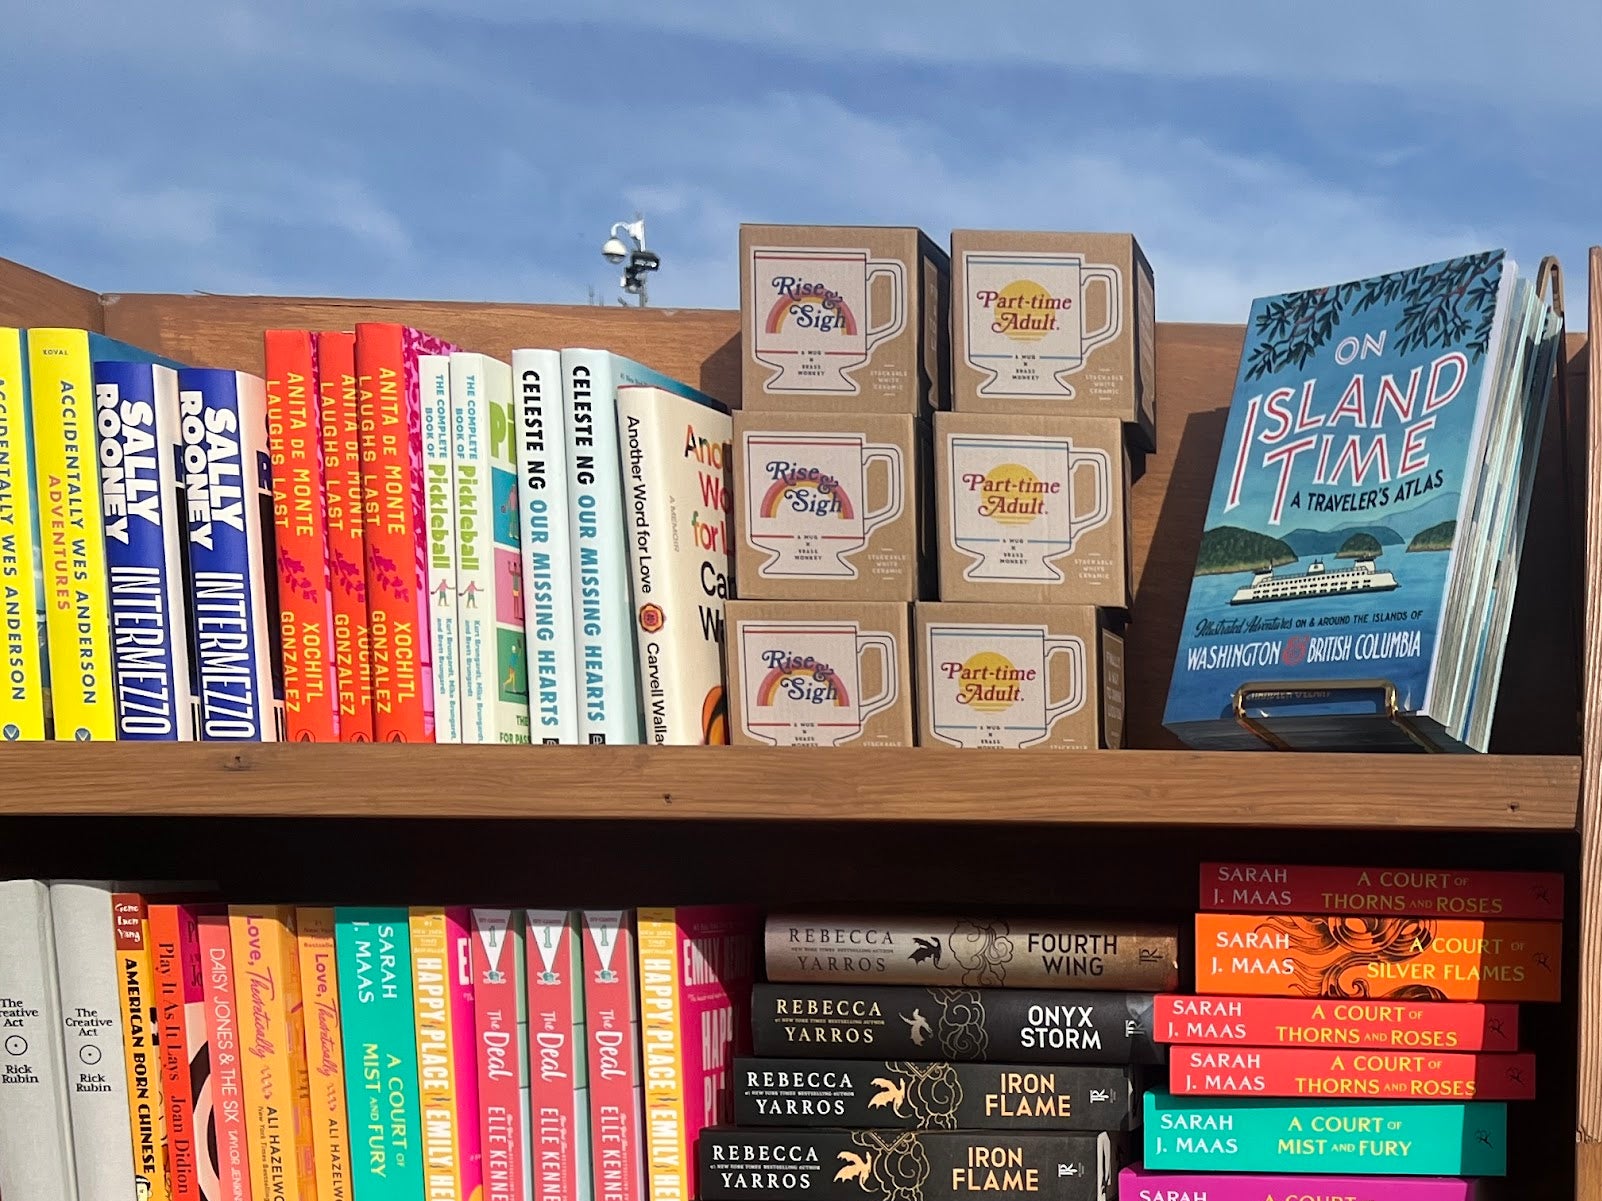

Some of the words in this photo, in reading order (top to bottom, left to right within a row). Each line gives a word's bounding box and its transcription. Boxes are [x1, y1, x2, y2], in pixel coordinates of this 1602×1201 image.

[772, 276, 824, 297] Rise
[976, 290, 1072, 314] Part-time
[790, 304, 847, 332] Sigh
[991, 313, 1060, 334] Adult.
[1335, 329, 1387, 366] ON
[287, 372, 302, 429] ANITA
[522, 369, 545, 452] CELESTE
[265, 379, 286, 466] LAUGHS
[1223, 351, 1470, 516] ISLAND
[60, 379, 84, 529] ACCIDENTALLY
[95, 383, 130, 546] ROONEY
[121, 399, 160, 526] SALLY
[291, 438, 305, 457] DE
[626, 415, 642, 479] Another
[527, 459, 546, 491] NG
[1262, 415, 1437, 526] TIME
[1291, 490, 1301, 509] A
[1307, 488, 1391, 513] TRAVELER'S
[1394, 469, 1444, 503] ATLAS
[272, 477, 289, 529] LAST
[292, 467, 314, 538] MONTE
[458, 464, 480, 571] Pickleball
[635, 481, 648, 517] Word
[529, 499, 549, 544] OUR
[636, 519, 648, 538] for
[48, 475, 71, 611] ADVENTURES
[72, 538, 88, 581] WES
[640, 540, 651, 594] Love
[533, 552, 554, 642] MISSING
[1295, 619, 1310, 630] ON
[1317, 616, 1351, 628] AROUND
[1353, 613, 1368, 624] THE
[1372, 611, 1408, 623] ISLANDS
[1411, 610, 1423, 620] OF
[75, 589, 97, 705] ANDERSON
[110, 565, 172, 736] INTERMEZZO
[280, 610, 300, 714] GONZALEZ
[301, 622, 323, 704] XOCHITL
[1187, 639, 1280, 671] WASHINGTON
[1307, 636, 1351, 663] BRITISH
[1355, 630, 1422, 660] COLUMBIA
[537, 649, 559, 727] HEARTS
[646, 641, 662, 700] Carvell
[789, 928, 894, 945] REBECCA
[1028, 933, 1118, 954] FOURTH
[1216, 932, 1290, 950] SARAH
[797, 955, 886, 973] YARROS
[1042, 955, 1104, 976] WING
[1211, 957, 1223, 975] J.
[1231, 957, 1295, 976] MAAS
[1367, 962, 1435, 981] SILVER
[1443, 964, 1525, 982] FLAMES
[124, 958, 144, 1050] AMERICAN
[416, 957, 443, 1022] HAPPY
[65, 1018, 113, 1027] Creative
[75, 1008, 97, 1017] The
[79, 1027, 97, 1036] Act
[1027, 1005, 1094, 1027] ONYX
[1020, 1028, 1101, 1050] STORM
[80, 1074, 105, 1082] Rick
[133, 1051, 149, 1100] BORN
[420, 1030, 449, 1091] PLACE
[76, 1083, 112, 1092] Rubin
[1000, 1073, 1055, 1094] IRON
[266, 1106, 278, 1129] ALI
[487, 1106, 504, 1143] ELLE
[985, 1095, 1071, 1117] FLAME
[138, 1103, 156, 1174] CHINESE
[425, 1109, 453, 1168] EMILY
[1277, 1138, 1326, 1155] MIST
[1331, 1143, 1355, 1152] AND
[1359, 1140, 1412, 1157] FURY
